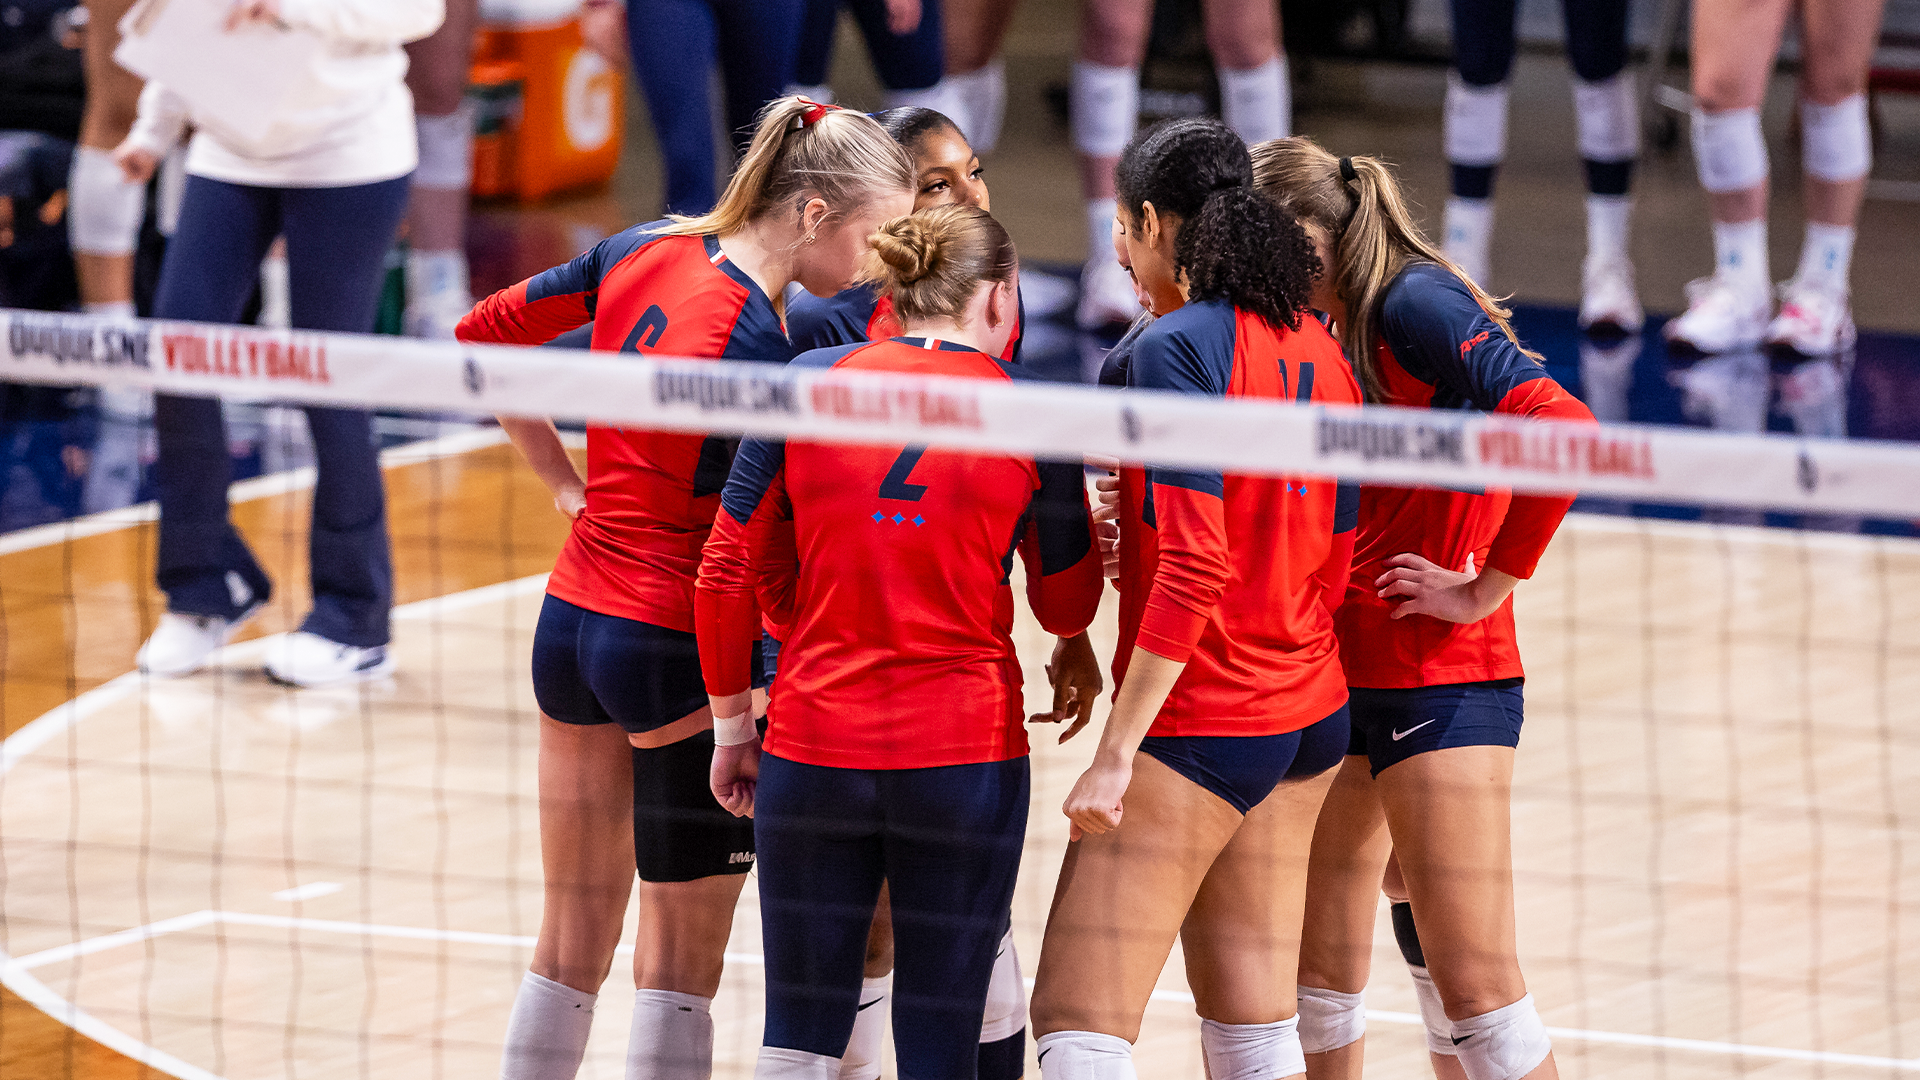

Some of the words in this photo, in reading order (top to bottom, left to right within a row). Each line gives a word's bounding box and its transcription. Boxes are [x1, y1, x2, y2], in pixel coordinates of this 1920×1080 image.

[563, 48, 613, 151] G
[9, 318, 151, 370] DUQUESNE
[161, 330, 331, 386] VOLLEYBALL
[810, 382, 986, 433] VOLLEYBALL
[1477, 428, 1657, 481] VOLLEYBALL
